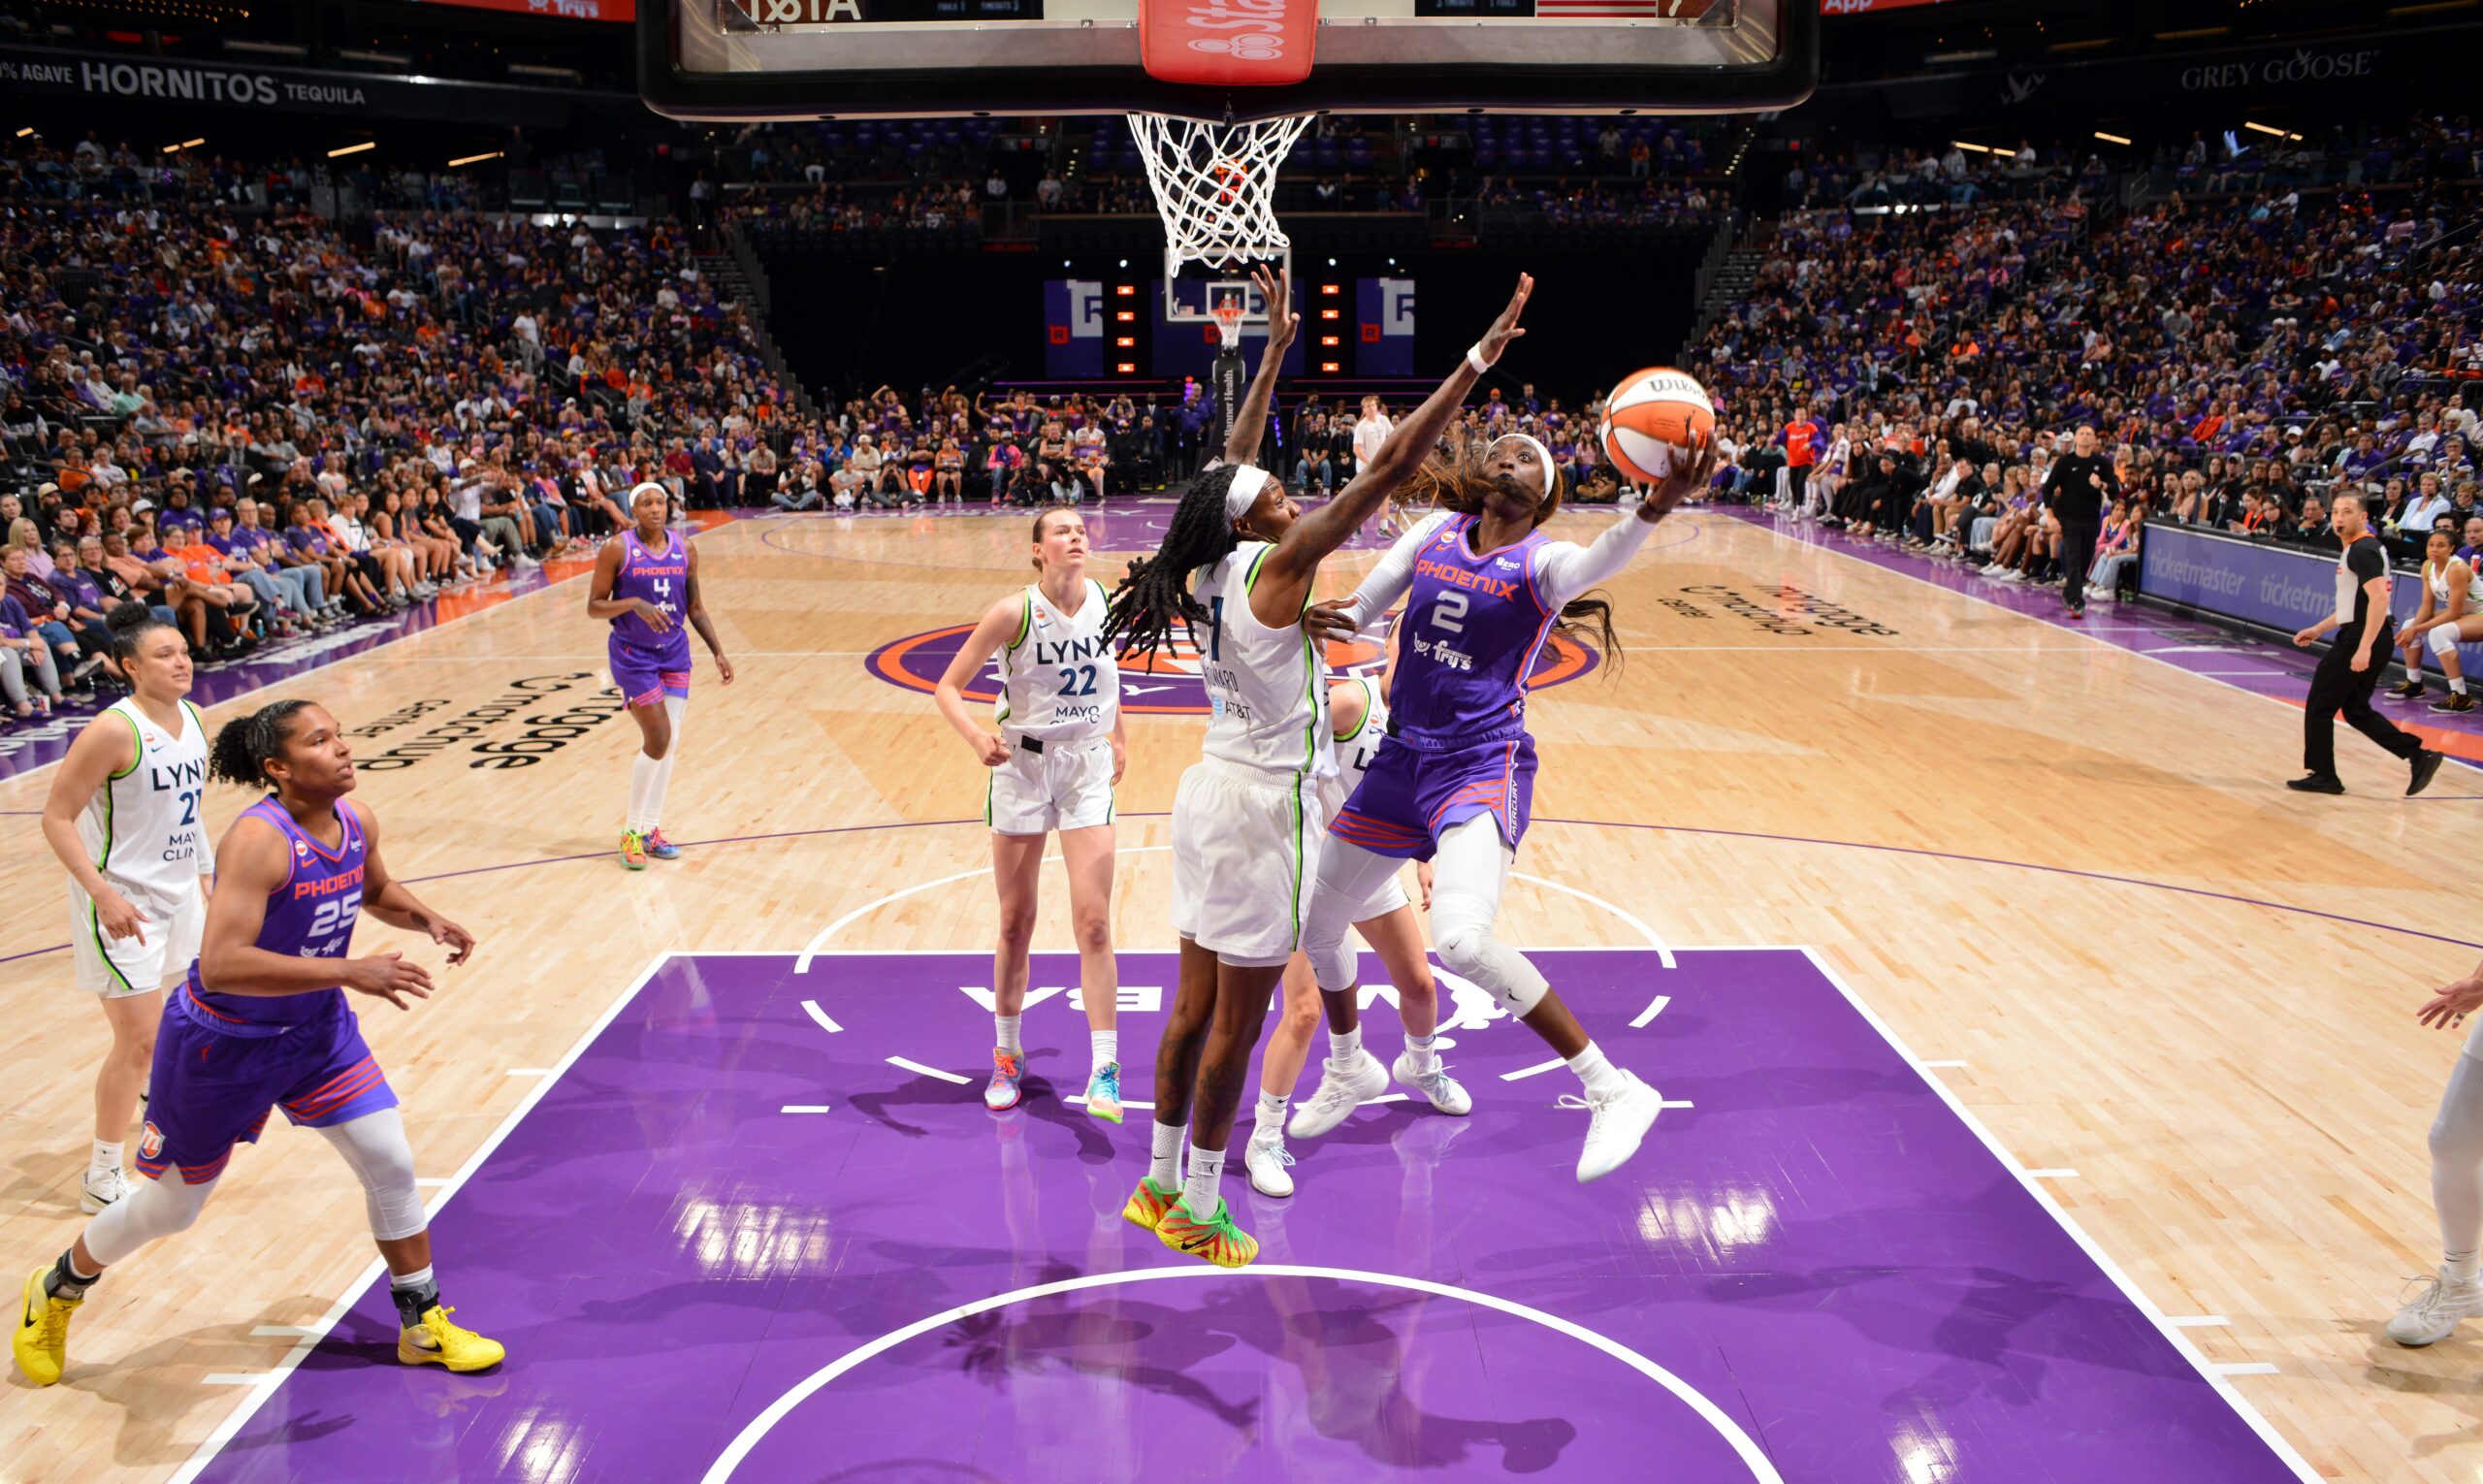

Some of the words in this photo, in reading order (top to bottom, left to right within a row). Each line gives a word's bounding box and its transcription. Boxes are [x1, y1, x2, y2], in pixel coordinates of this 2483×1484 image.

[22, 64, 74, 84] AGAVE
[81, 62, 278, 105] HORNITOS
[285, 83, 366, 105] TEQUILA
[2180, 63, 2255, 90] GREY
[2263, 49, 2372, 84] GOOSE
[1224, 370, 1234, 402] Health
[1224, 402, 1234, 436] Banner
[632, 566, 684, 577] PHOENIX
[654, 578, 671, 597] 4
[1415, 560, 1520, 602] PHOENIX
[2149, 551, 2245, 597] ticketmaster
[1431, 589, 1469, 633] 2
[1036, 635, 1110, 665] LYNX
[1433, 640, 1473, 670] fry's
[1057, 664, 1097, 696] 22
[1055, 705, 1100, 718] MAYO
[1225, 700, 1250, 721] AT&T
[469, 687, 624, 770] rtgage
[307, 889, 362, 938] 25
